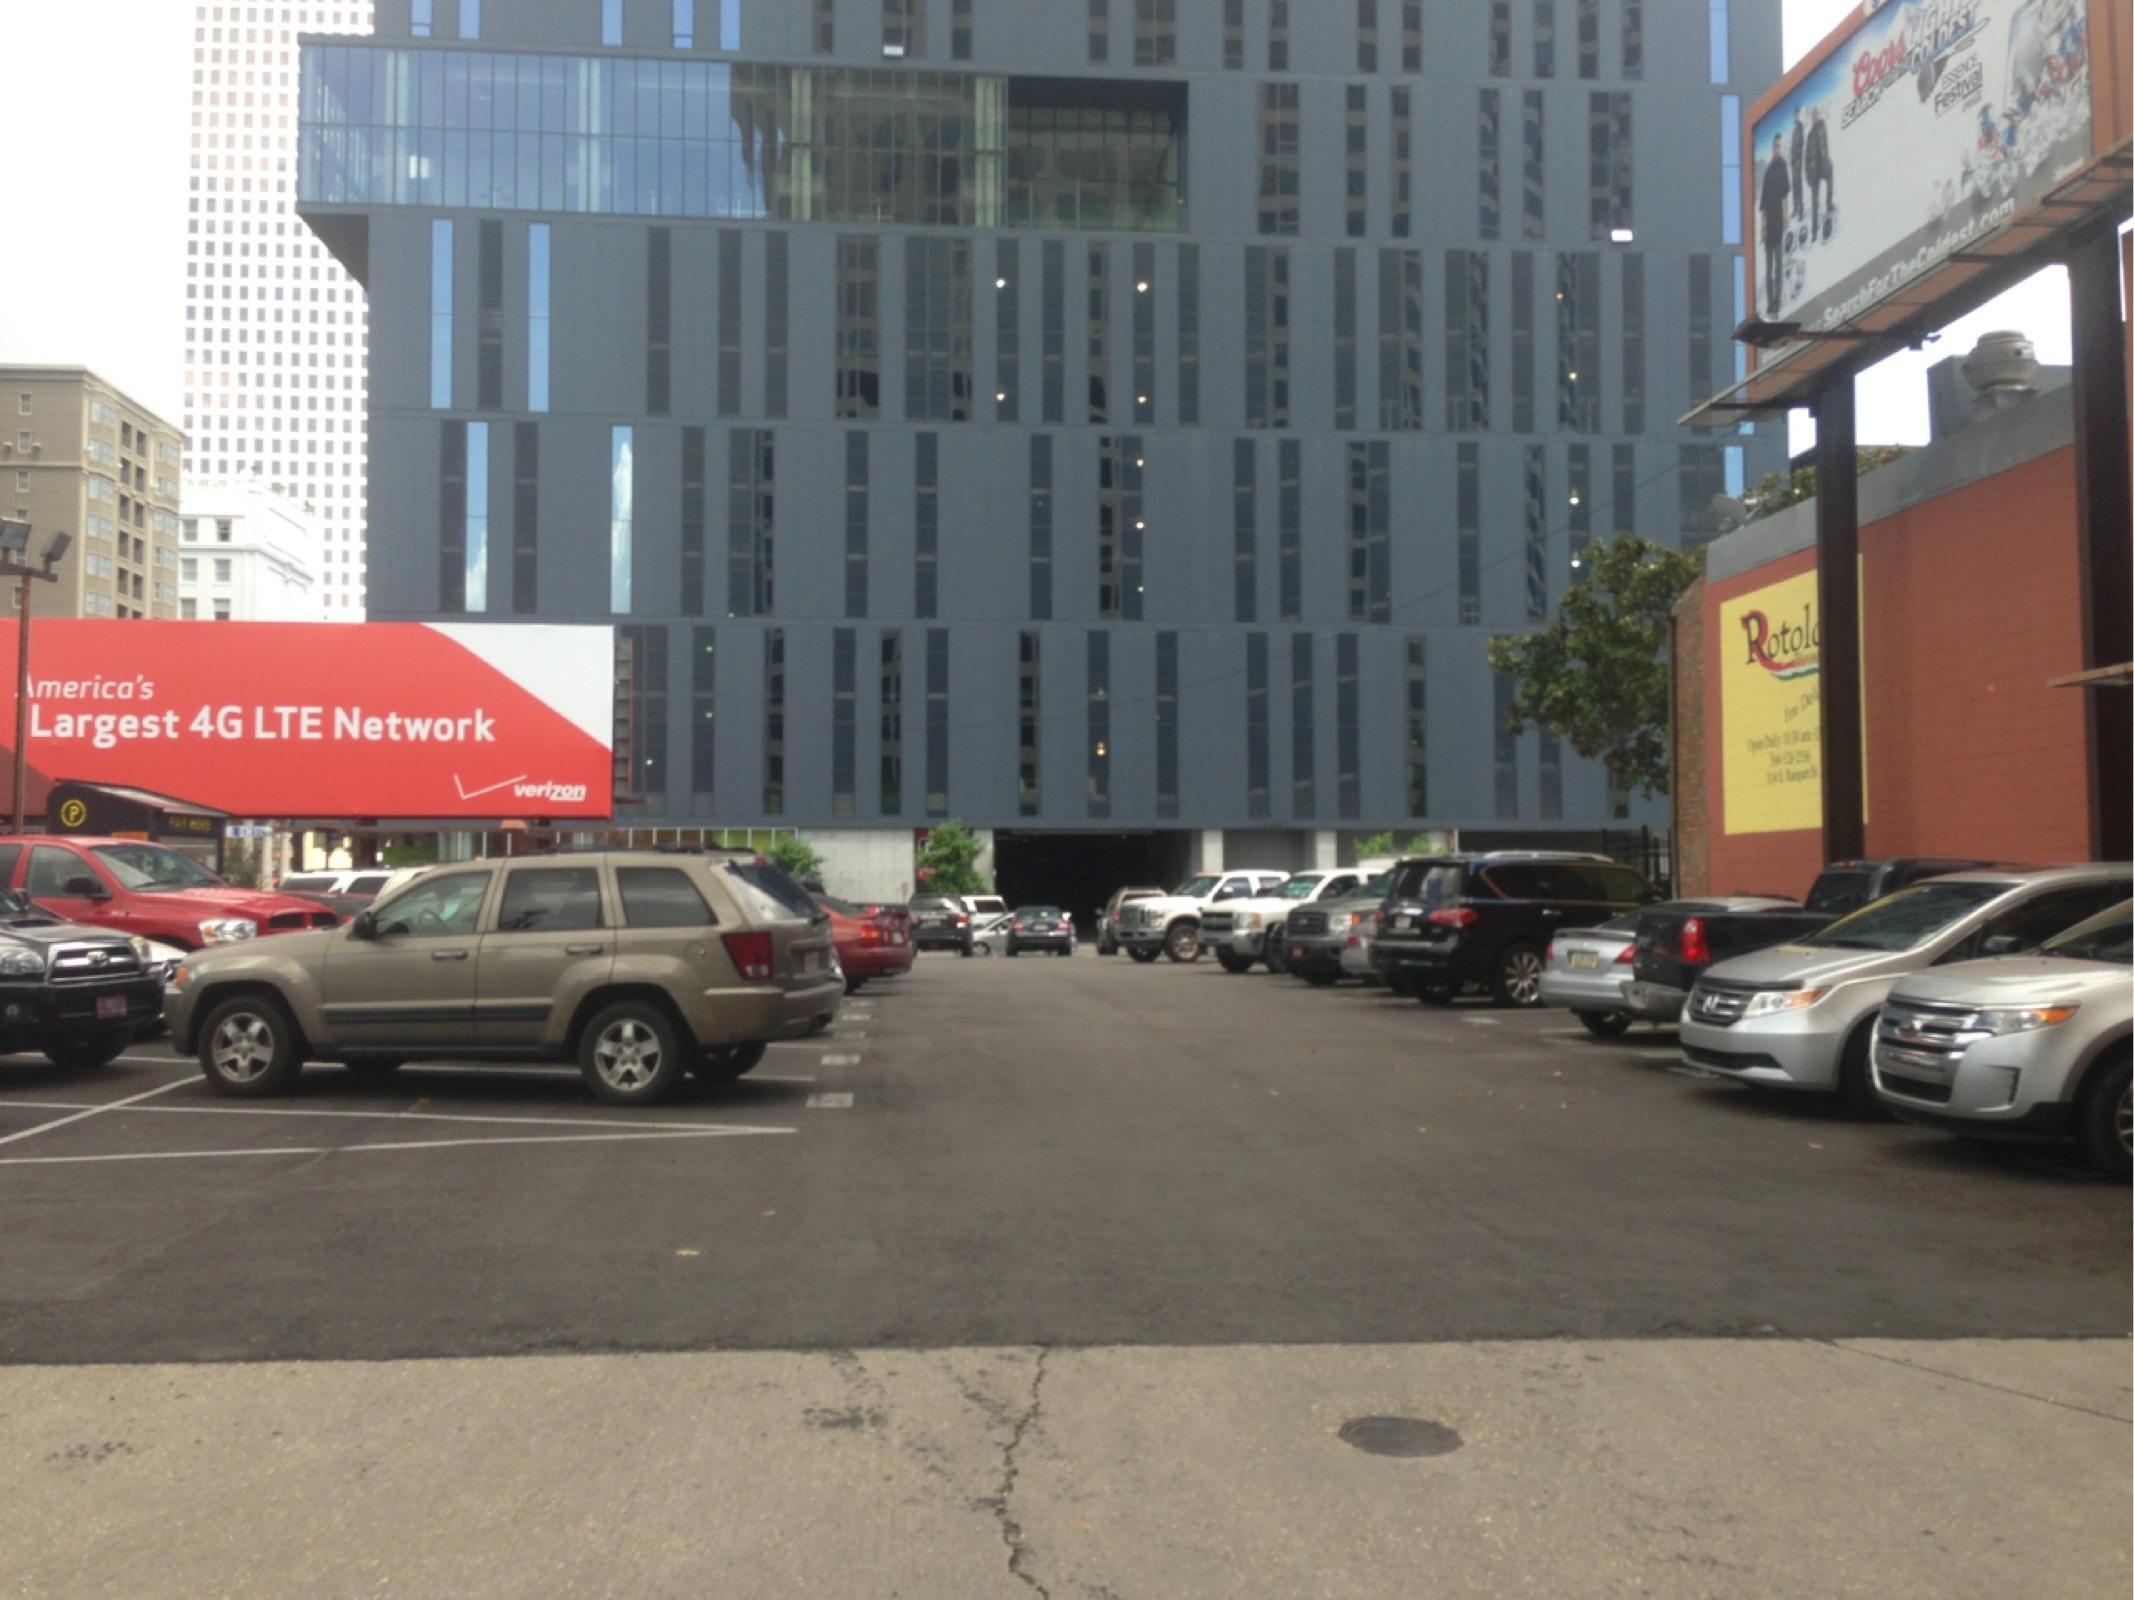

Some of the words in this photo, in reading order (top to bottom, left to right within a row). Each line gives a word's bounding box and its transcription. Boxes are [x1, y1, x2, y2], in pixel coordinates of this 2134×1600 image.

[31, 703, 180, 748] Largest
[189, 704, 243, 739] 4G
[254, 706, 323, 739] LTE
[334, 706, 496, 742] Network
[514, 780, 587, 801] verizon
